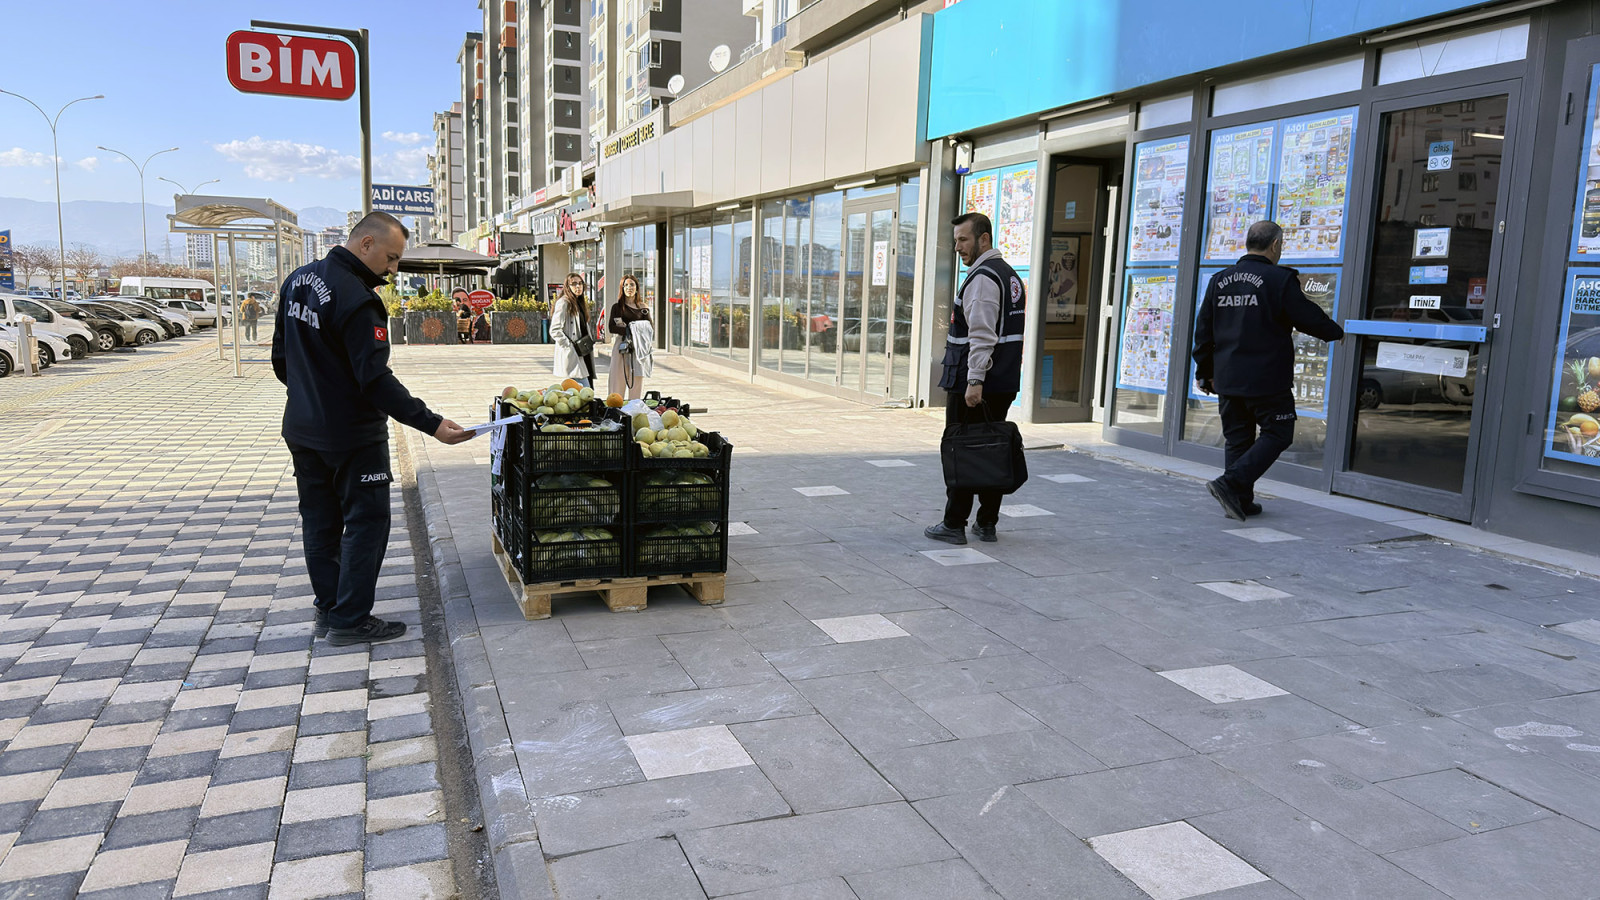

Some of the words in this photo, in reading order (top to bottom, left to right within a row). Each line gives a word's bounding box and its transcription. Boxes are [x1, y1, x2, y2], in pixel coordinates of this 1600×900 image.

[239, 35, 343, 88] BİM
[1433, 144, 1450, 153] GİRİŞ
[396, 190, 434, 204] ÇARŞI
[1217, 272, 1264, 289] BÜYÜKŞEHİR
[1304, 278, 1330, 292] Üstad
[1217, 294, 1259, 307] ZABITA
[360, 472, 389, 482] ZABITA
